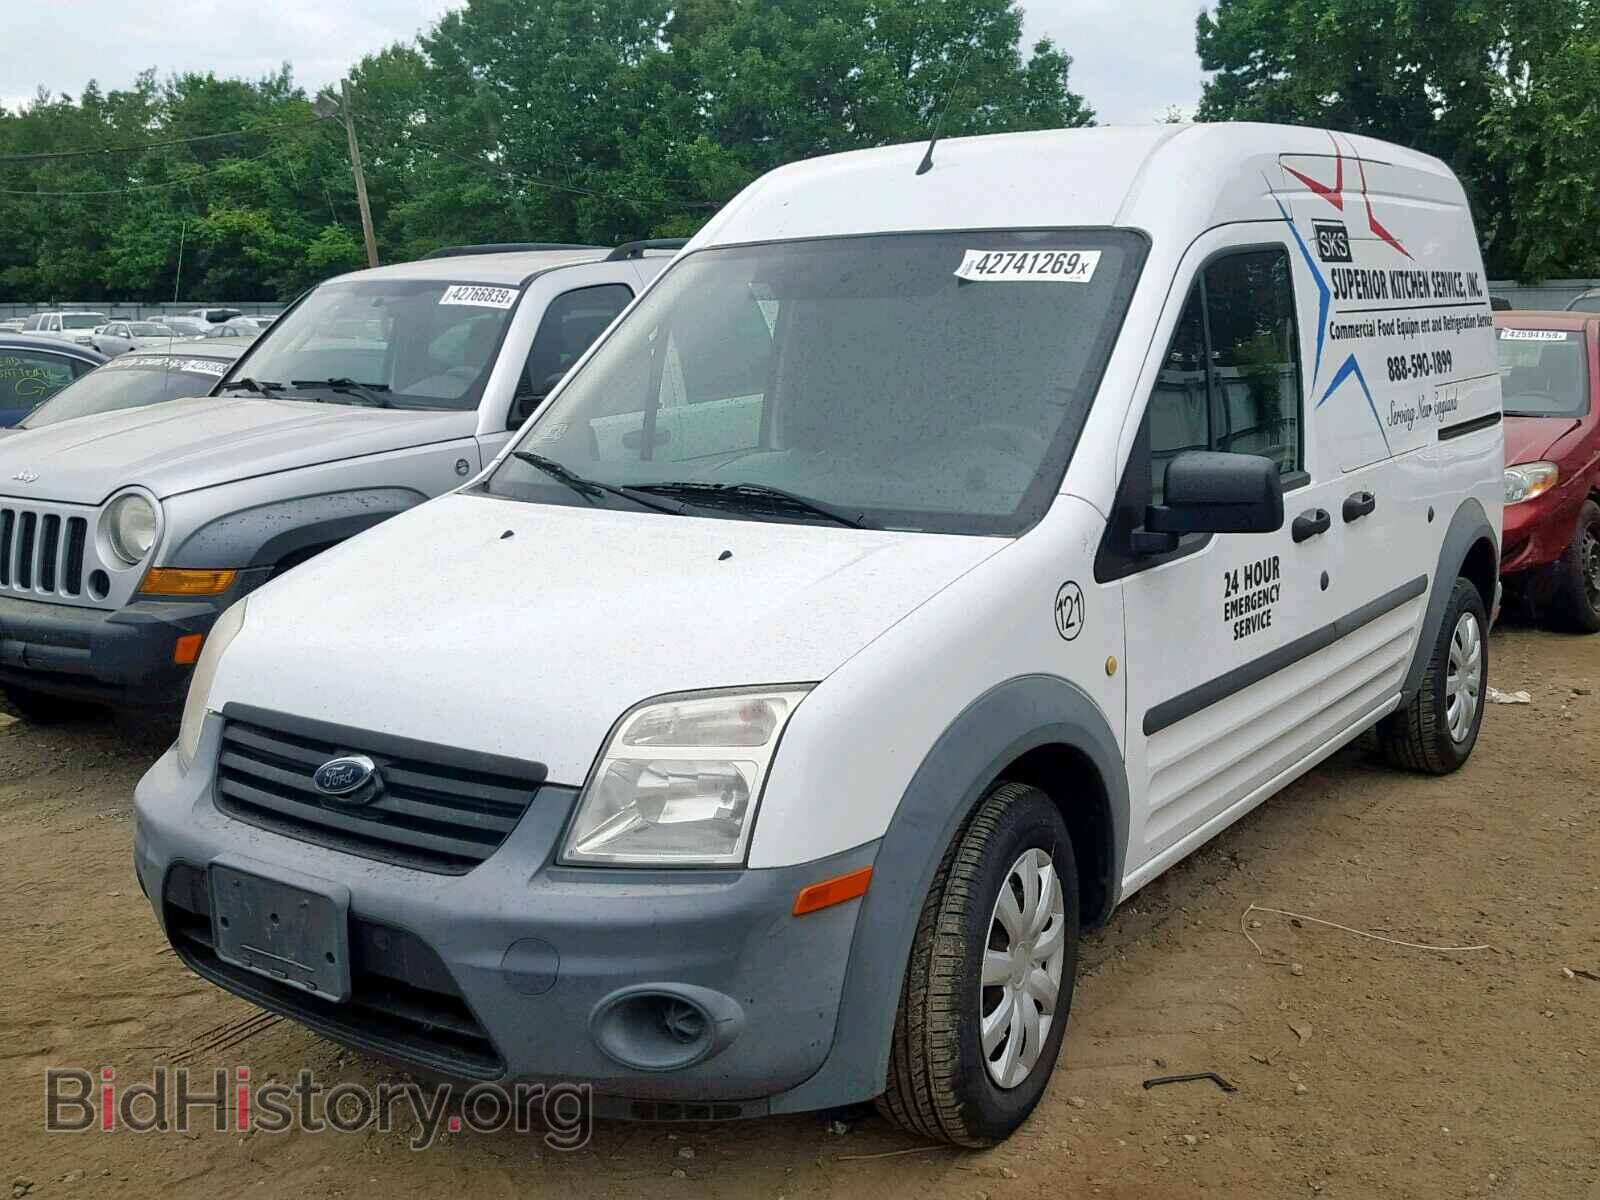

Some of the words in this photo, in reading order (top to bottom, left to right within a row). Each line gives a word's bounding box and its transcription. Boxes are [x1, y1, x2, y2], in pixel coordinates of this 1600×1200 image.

[1320, 231, 1348, 257] SKS
[1330, 267, 1388, 300] SUPERIOR
[1389, 269, 1430, 300] KITCHEN
[1431, 270, 1466, 301] SERVICE,
[1466, 271, 1483, 298] INC.
[1329, 318, 1376, 341] Commercial
[1377, 319, 1395, 337] Food
[1431, 315, 1443, 333] and
[1477, 312, 1494, 328] Service
[1387, 349, 1452, 382] 888-590-1899
[1387, 400, 1416, 431] Serving
[1415, 394, 1433, 420] New
[1434, 387, 1458, 423] England
[1224, 571, 1240, 598] 24
[1244, 555, 1281, 591] HOUR
[1057, 591, 1082, 631] 121
[1224, 582, 1281, 622] EMERGENCY
[1233, 608, 1273, 641] SERVICE
[323, 765, 354, 788] Ford
